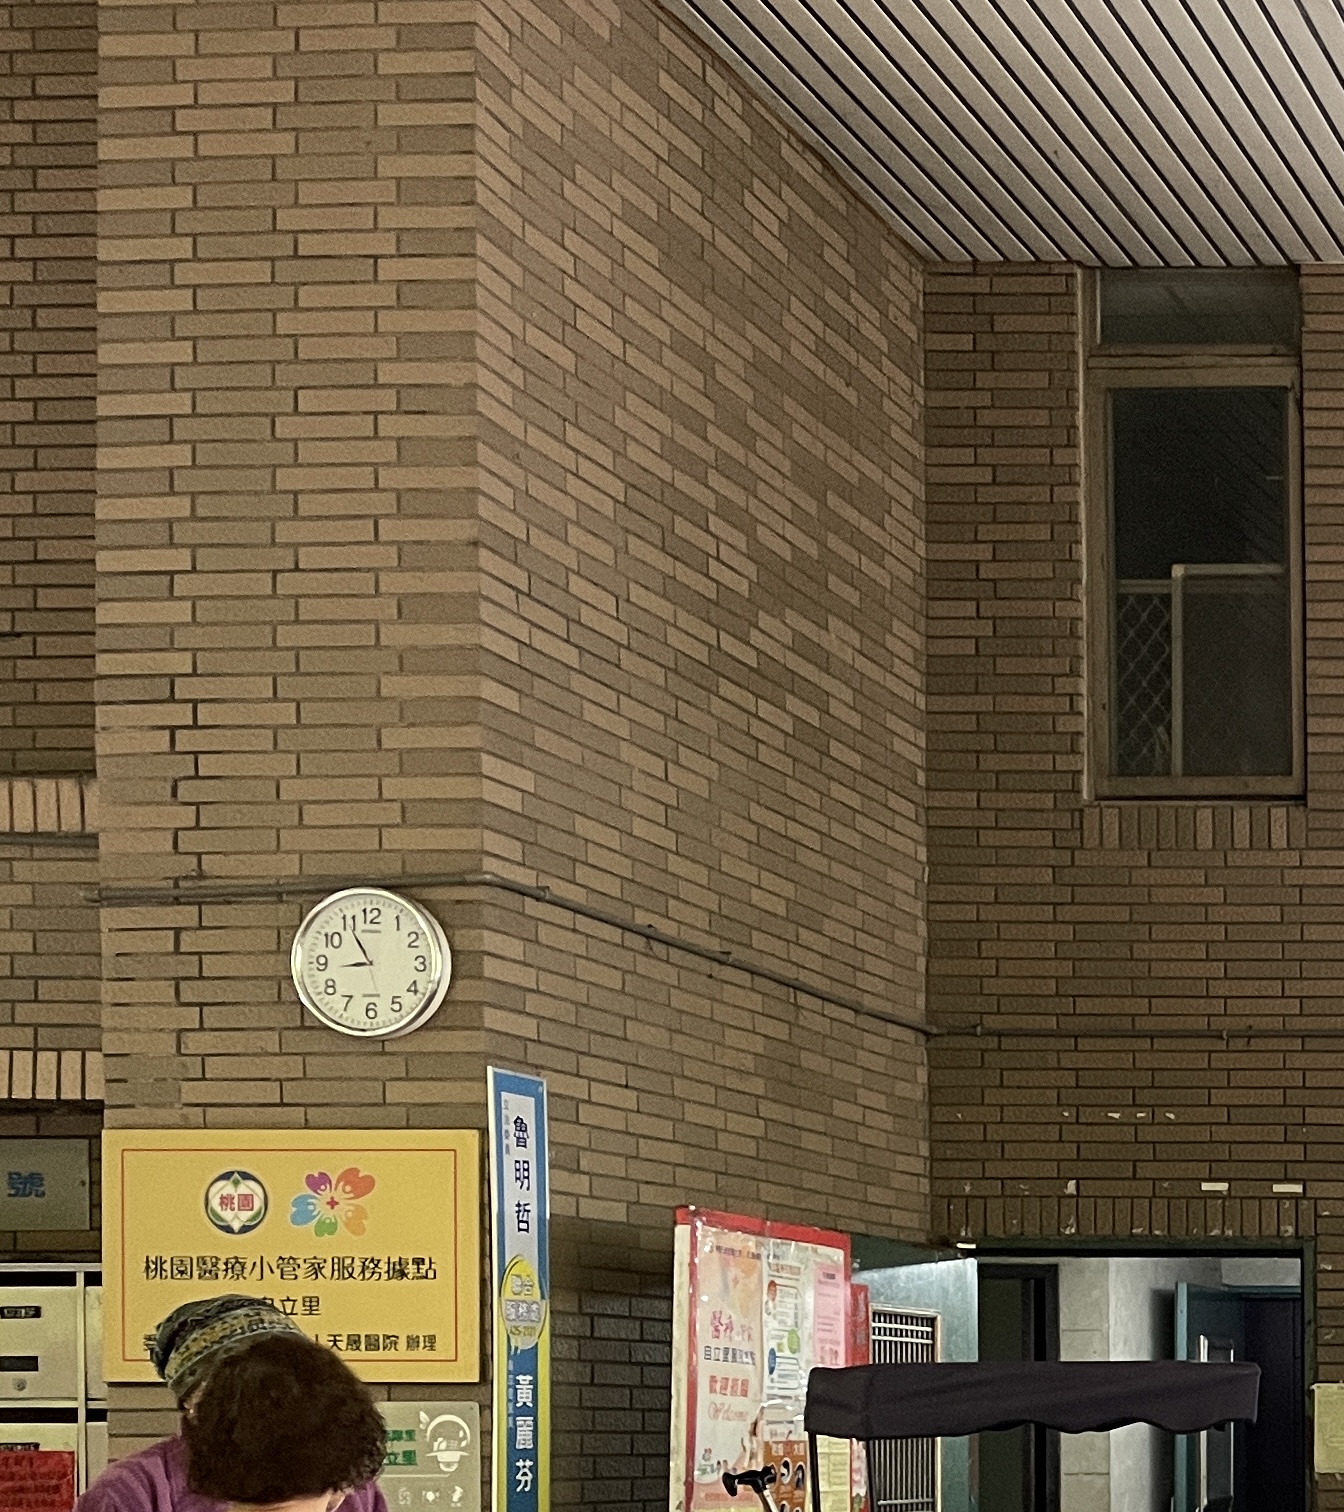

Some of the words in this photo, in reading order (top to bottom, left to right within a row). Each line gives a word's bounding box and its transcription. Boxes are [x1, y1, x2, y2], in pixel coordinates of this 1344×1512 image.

[342, 914, 356, 931] 11
[362, 908, 381, 924] 12
[324, 932, 342, 949] 10
[407, 931, 420, 948] 2
[316, 955, 328, 971] 9
[414, 955, 427, 972] 3
[324, 978, 336, 995] 8
[406, 980, 419, 996] 4
[341, 995, 353, 1012] 7
[365, 1002, 377, 1019] 6
[390, 996, 402, 1012] 5
[513, 1115, 531, 1234] 魯明哲
[8, 1172, 46, 1198] 號
[219, 1193, 255, 1211] 桃園
[143, 1255, 437, 1281] 桃園醫療小管家服務據點
[326, 1333, 400, 1353] 天晟醫院
[405, 1334, 437, 1352] 辦理
[515, 1374, 533, 1492] 黃麗芬
